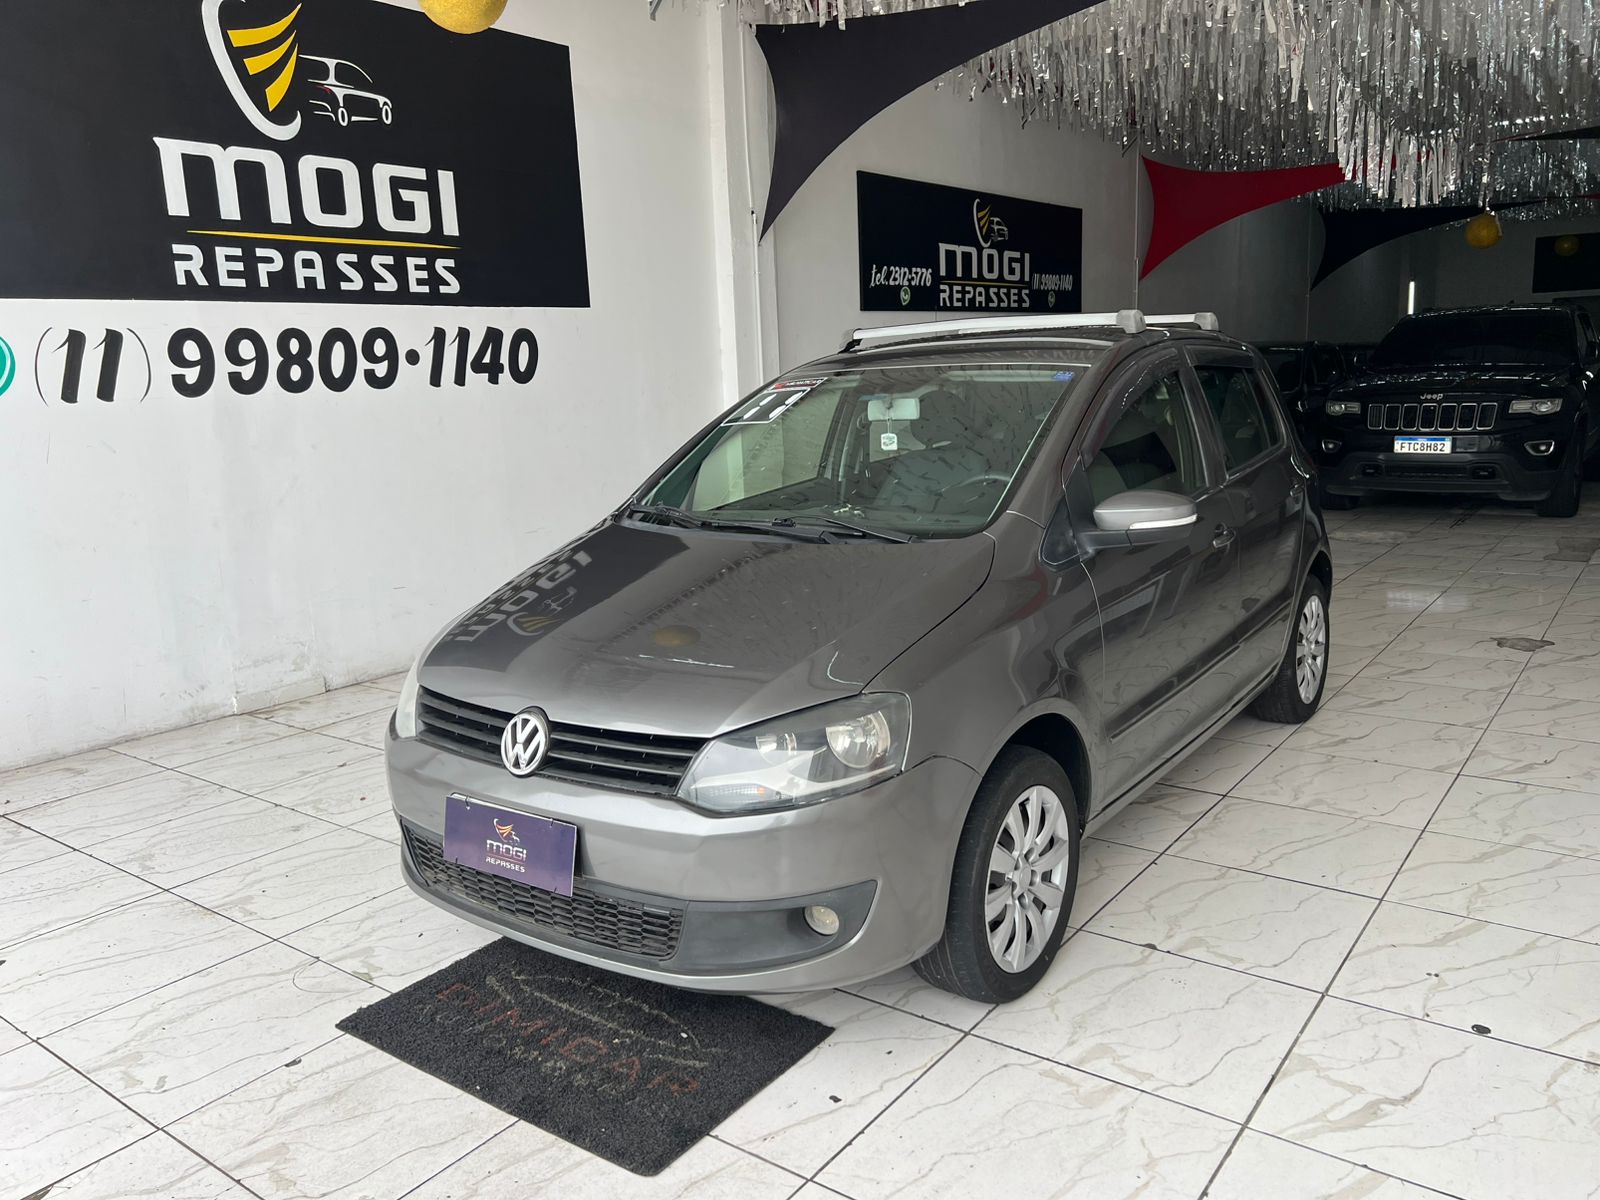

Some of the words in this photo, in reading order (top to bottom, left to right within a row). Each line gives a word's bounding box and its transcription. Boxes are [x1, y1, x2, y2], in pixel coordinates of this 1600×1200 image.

[153, 136, 460, 236] MOGI
[171, 243, 460, 294] REPASSES
[938, 242, 1030, 282] MOGI
[939, 284, 1030, 308] REPASSES
[34, 327, 152, 406] (11)
[1420, 393, 1443, 401] Jeep
[1400, 442, 1446, 452] FTC8H82
[486, 839, 527, 862] MOGI
[485, 856, 526, 873] REPASSES
